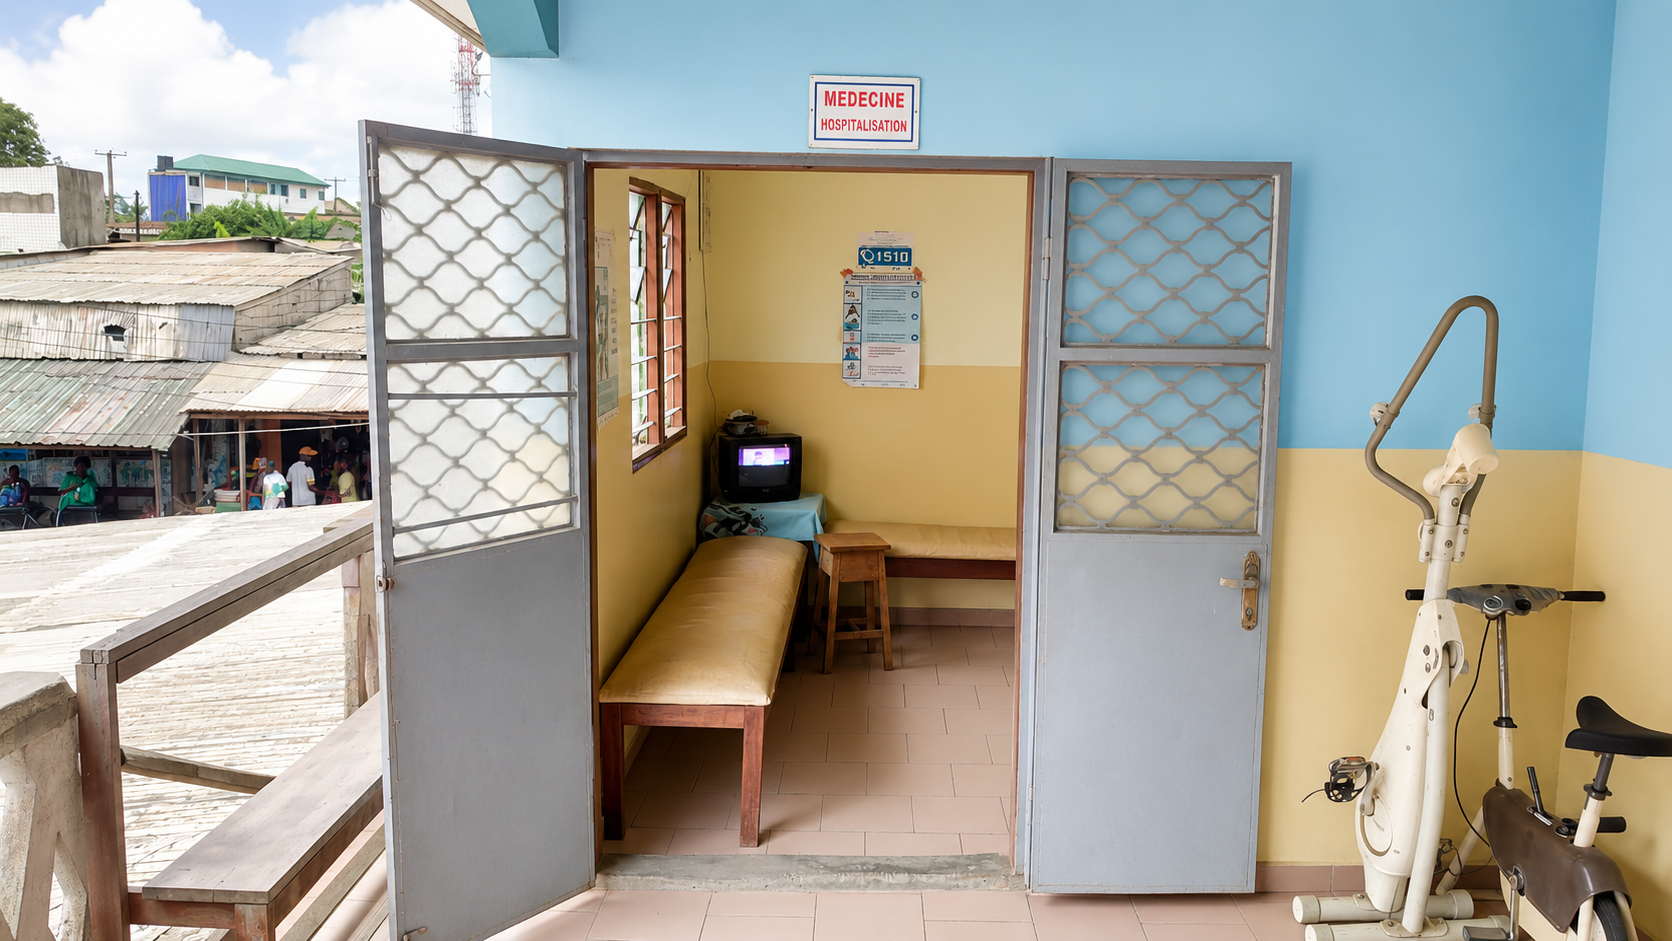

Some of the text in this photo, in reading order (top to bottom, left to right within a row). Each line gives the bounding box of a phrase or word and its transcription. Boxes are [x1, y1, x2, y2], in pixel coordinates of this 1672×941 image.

[824, 90, 905, 108] MEDECINE
[821, 118, 907, 132] HOSPITALISATION
[876, 251, 909, 263] 1510
